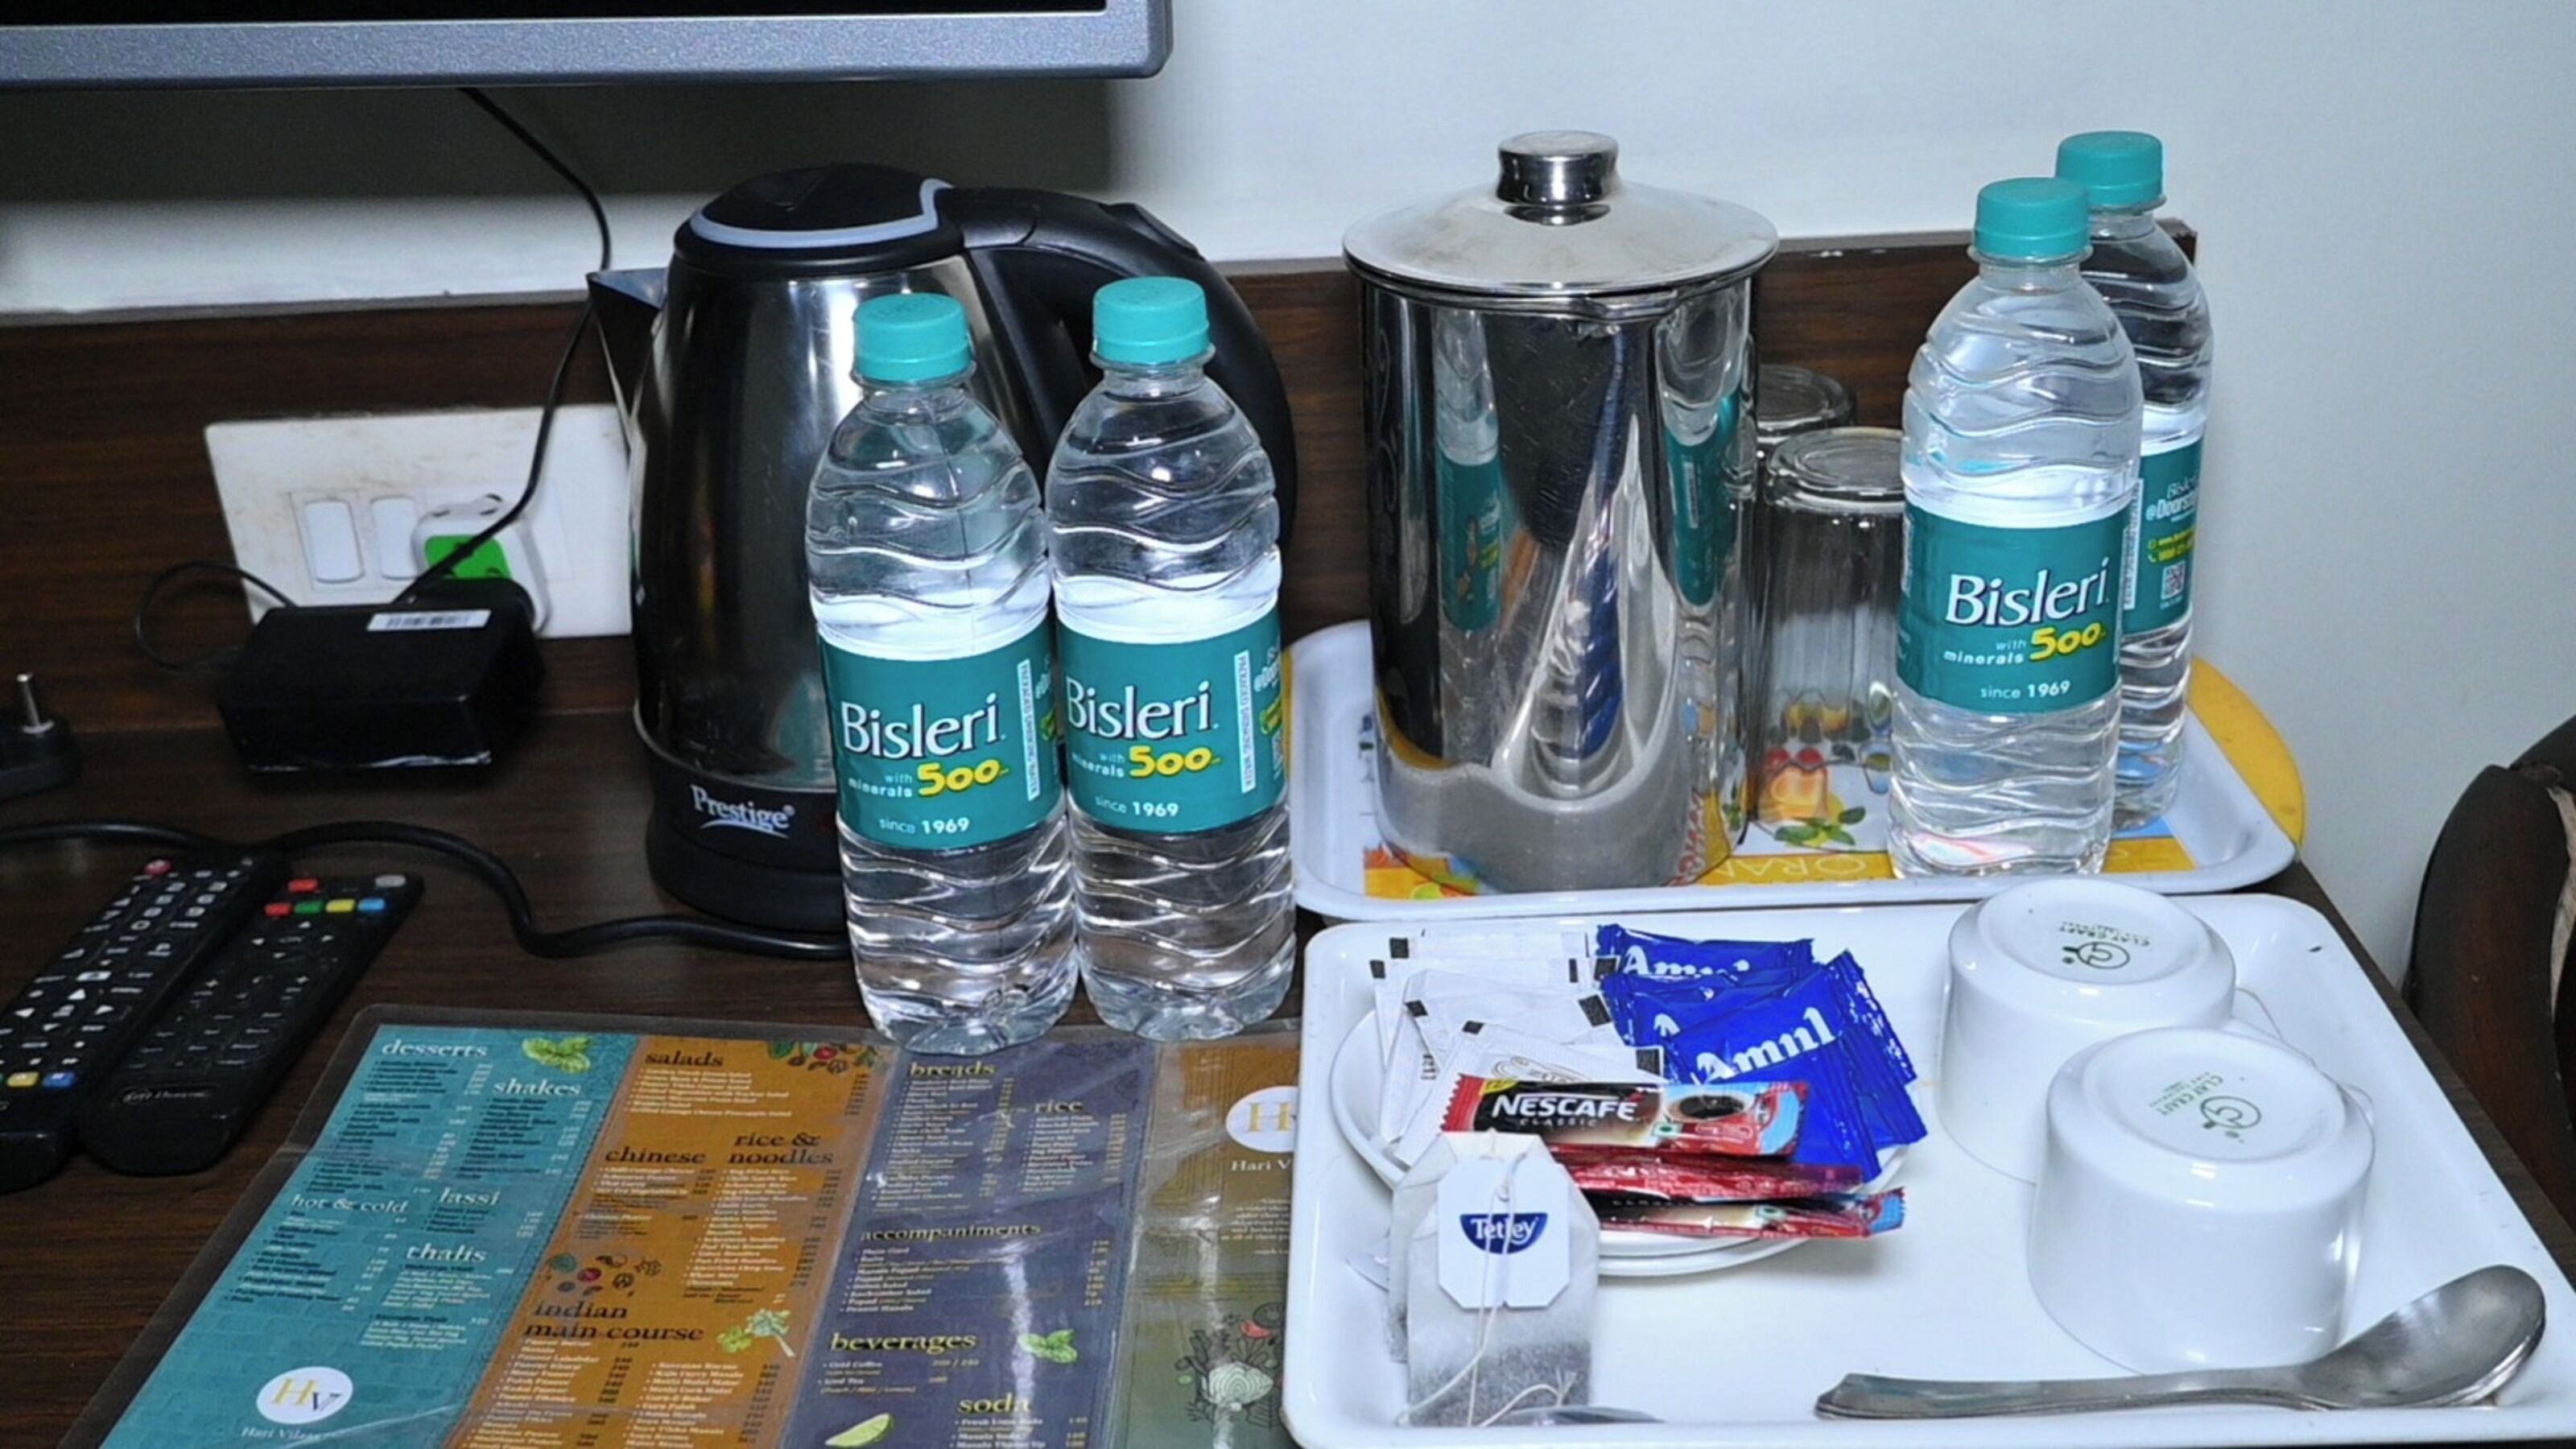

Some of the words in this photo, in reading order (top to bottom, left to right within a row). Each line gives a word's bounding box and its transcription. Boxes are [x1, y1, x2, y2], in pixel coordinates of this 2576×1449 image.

[1945, 556, 2110, 627] Bisleri
[1996, 639, 2026, 651] with
[2029, 622, 2103, 662] 500
[1943, 650, 2025, 665] minerals
[1979, 686, 2021, 700] since
[2027, 680, 2071, 699] 1969
[1067, 680, 1210, 739] Bisleri
[840, 691, 1001, 759] Bisleri
[1071, 753, 1125, 778] minerals
[1100, 753, 1125, 763] with
[1129, 745, 1212, 778] 500
[848, 777, 914, 798] minerals
[885, 773, 914, 784] with
[917, 759, 1003, 796] 500
[690, 783, 791, 831] Prestige
[1095, 795, 1127, 814] since
[1133, 801, 1179, 816] 1969
[878, 816, 915, 834] since
[921, 815, 970, 834] 1969
[382, 1038, 489, 1058] desserts
[645, 1050, 724, 1068] salads
[909, 1060, 997, 1077] breads
[491, 1077, 582, 1096] shakes
[1033, 1098, 1085, 1114] rice
[734, 1132, 786, 1148] rice
[791, 1132, 822, 1147] &
[605, 1146, 707, 1164] chinese
[727, 1149, 835, 1166] noodles
[1231, 1159, 1273, 1172] Hari
[290, 1194, 332, 1208] hot
[359, 1199, 409, 1214] cold
[439, 1187, 502, 1206] lassi
[860, 1223, 1042, 1243] accompaniments
[406, 1242, 488, 1262] thalis
[533, 1299, 630, 1320] indian
[523, 1321, 599, 1340] main
[605, 1325, 706, 1342] course
[830, 1331, 979, 1356] beverages
[957, 1391, 1031, 1414] soda
